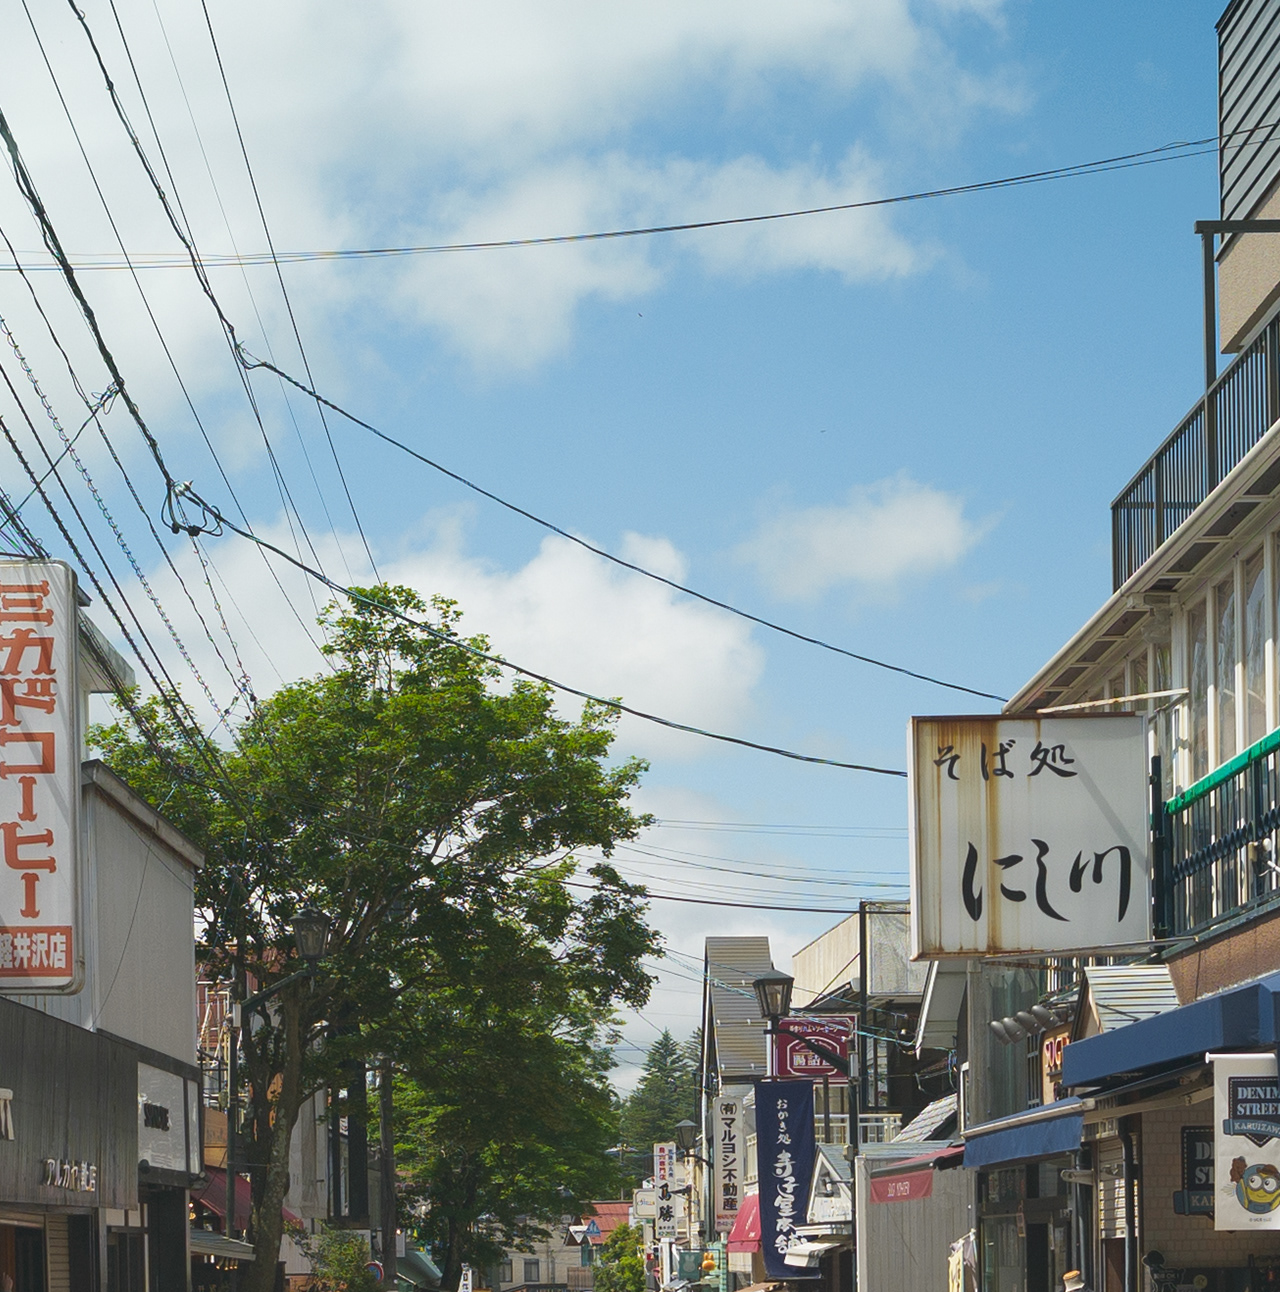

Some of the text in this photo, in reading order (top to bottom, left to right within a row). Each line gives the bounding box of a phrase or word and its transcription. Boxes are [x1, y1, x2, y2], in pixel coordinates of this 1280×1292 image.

[932, 738, 1079, 782] そば処
[962, 838, 1132, 924] にし川
[776, 1098, 792, 1146] おかき処
